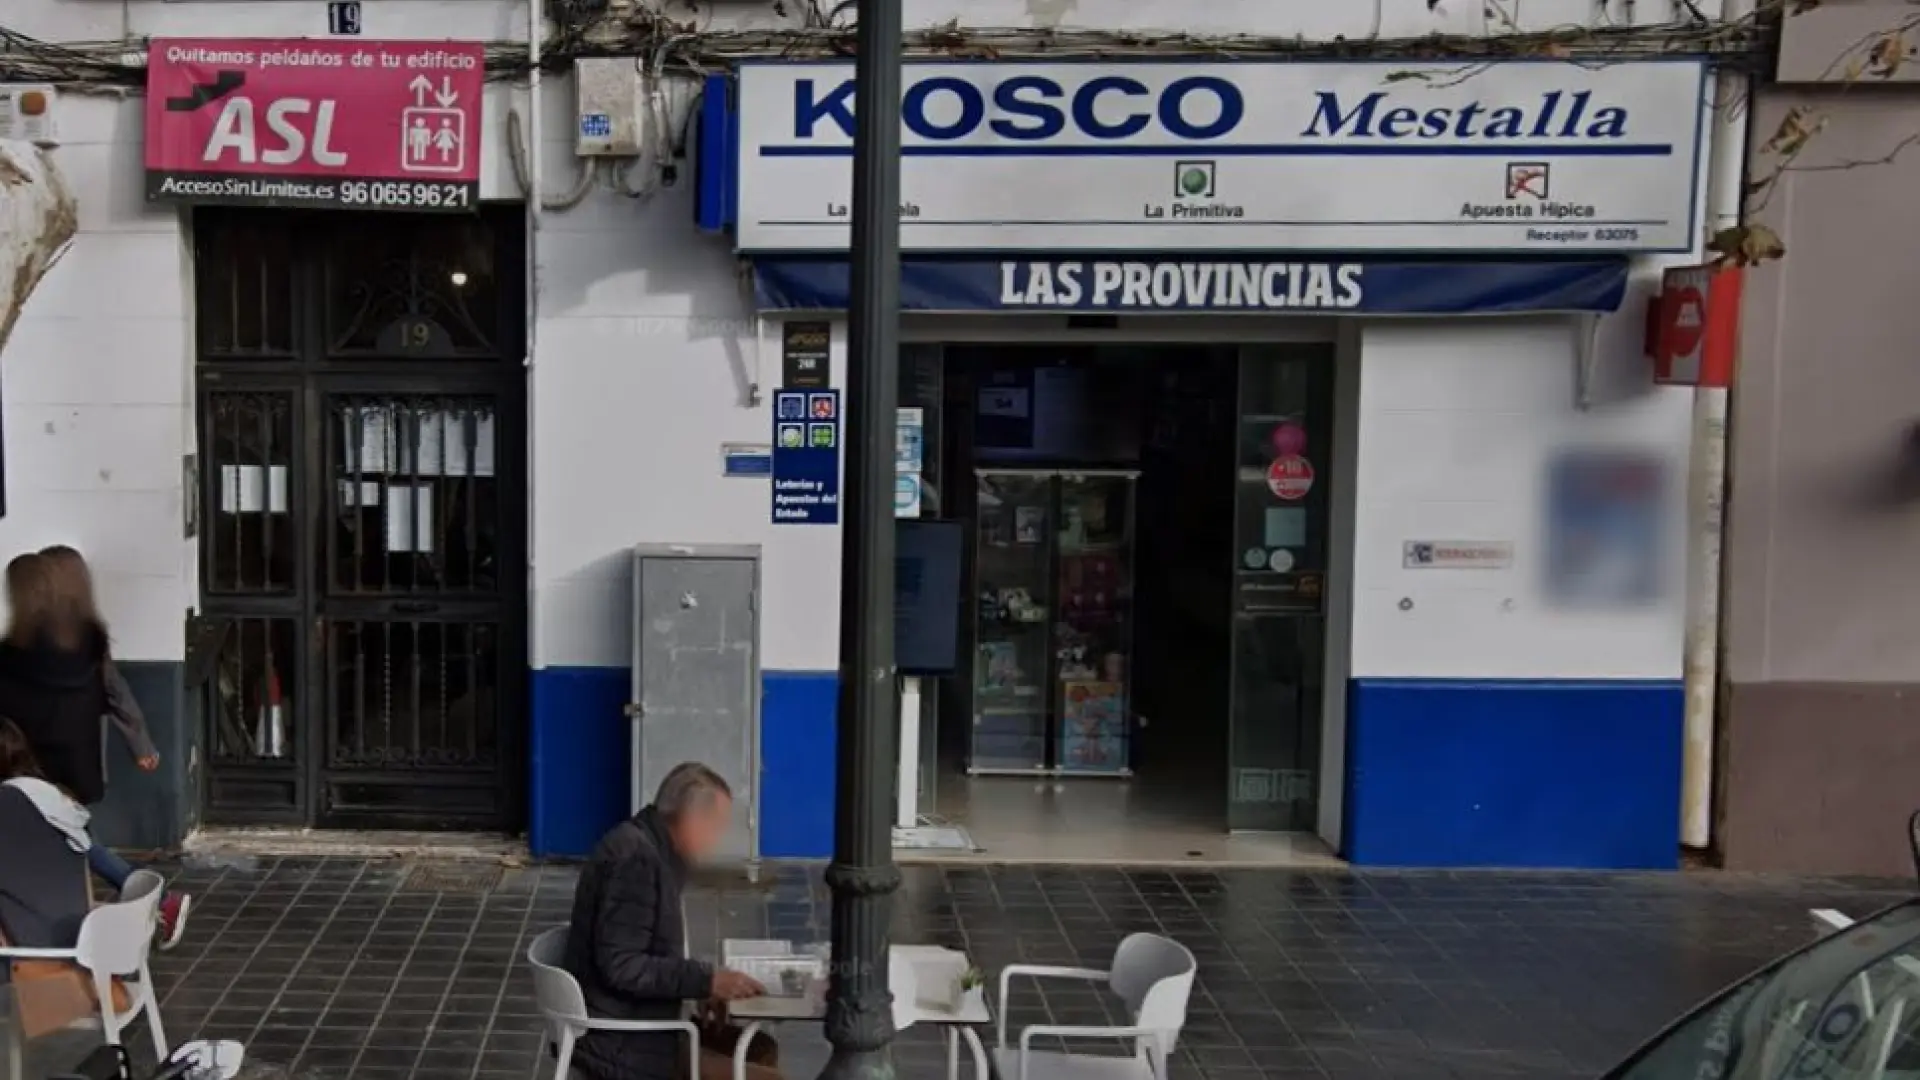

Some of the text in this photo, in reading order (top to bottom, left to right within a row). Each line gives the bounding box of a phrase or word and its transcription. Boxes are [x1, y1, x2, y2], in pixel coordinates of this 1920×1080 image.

[331, 3, 360, 33] 19
[167, 47, 475, 69] Quitamos peldaños de tu edificio
[793, 75, 1629, 140] KOSCO Mestalla
[203, 96, 348, 166] ASL
[160, 177, 335, 200] AccesoSinLimites.es
[826, 202, 848, 217] La
[1144, 202, 1245, 218] La Primitiva
[1460, 202, 1533, 219] Apuesta
[1526, 227, 1589, 243] Receptor
[1001, 262, 1363, 308] LAS PROVINCIAS
[401, 322, 429, 348] 19
